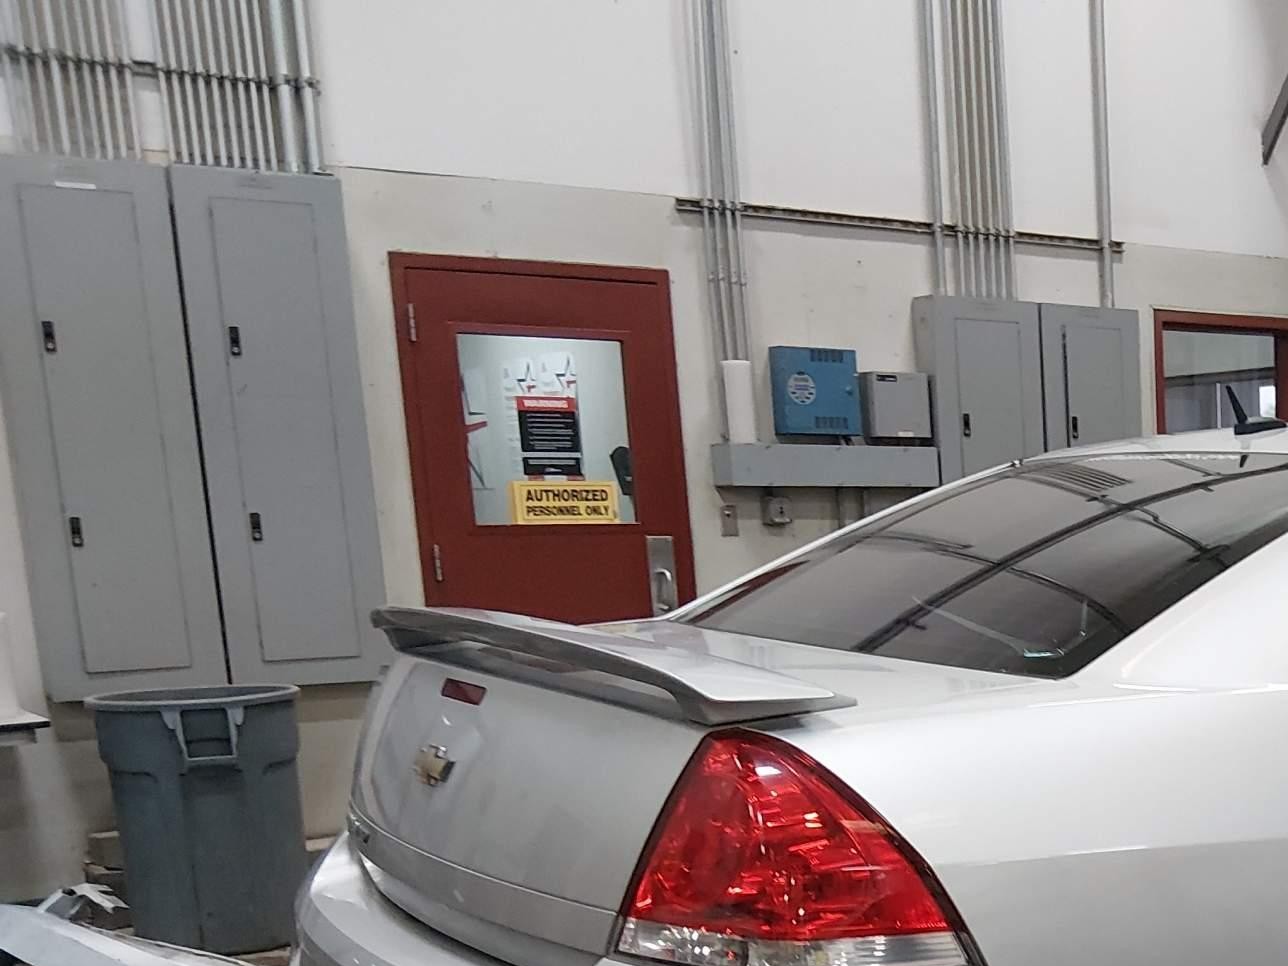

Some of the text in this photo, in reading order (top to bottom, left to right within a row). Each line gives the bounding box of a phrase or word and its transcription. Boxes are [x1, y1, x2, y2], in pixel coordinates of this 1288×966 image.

[526, 488, 609, 502] AUTHORIZED
[526, 505, 609, 516] PERSONNEL ONLY
